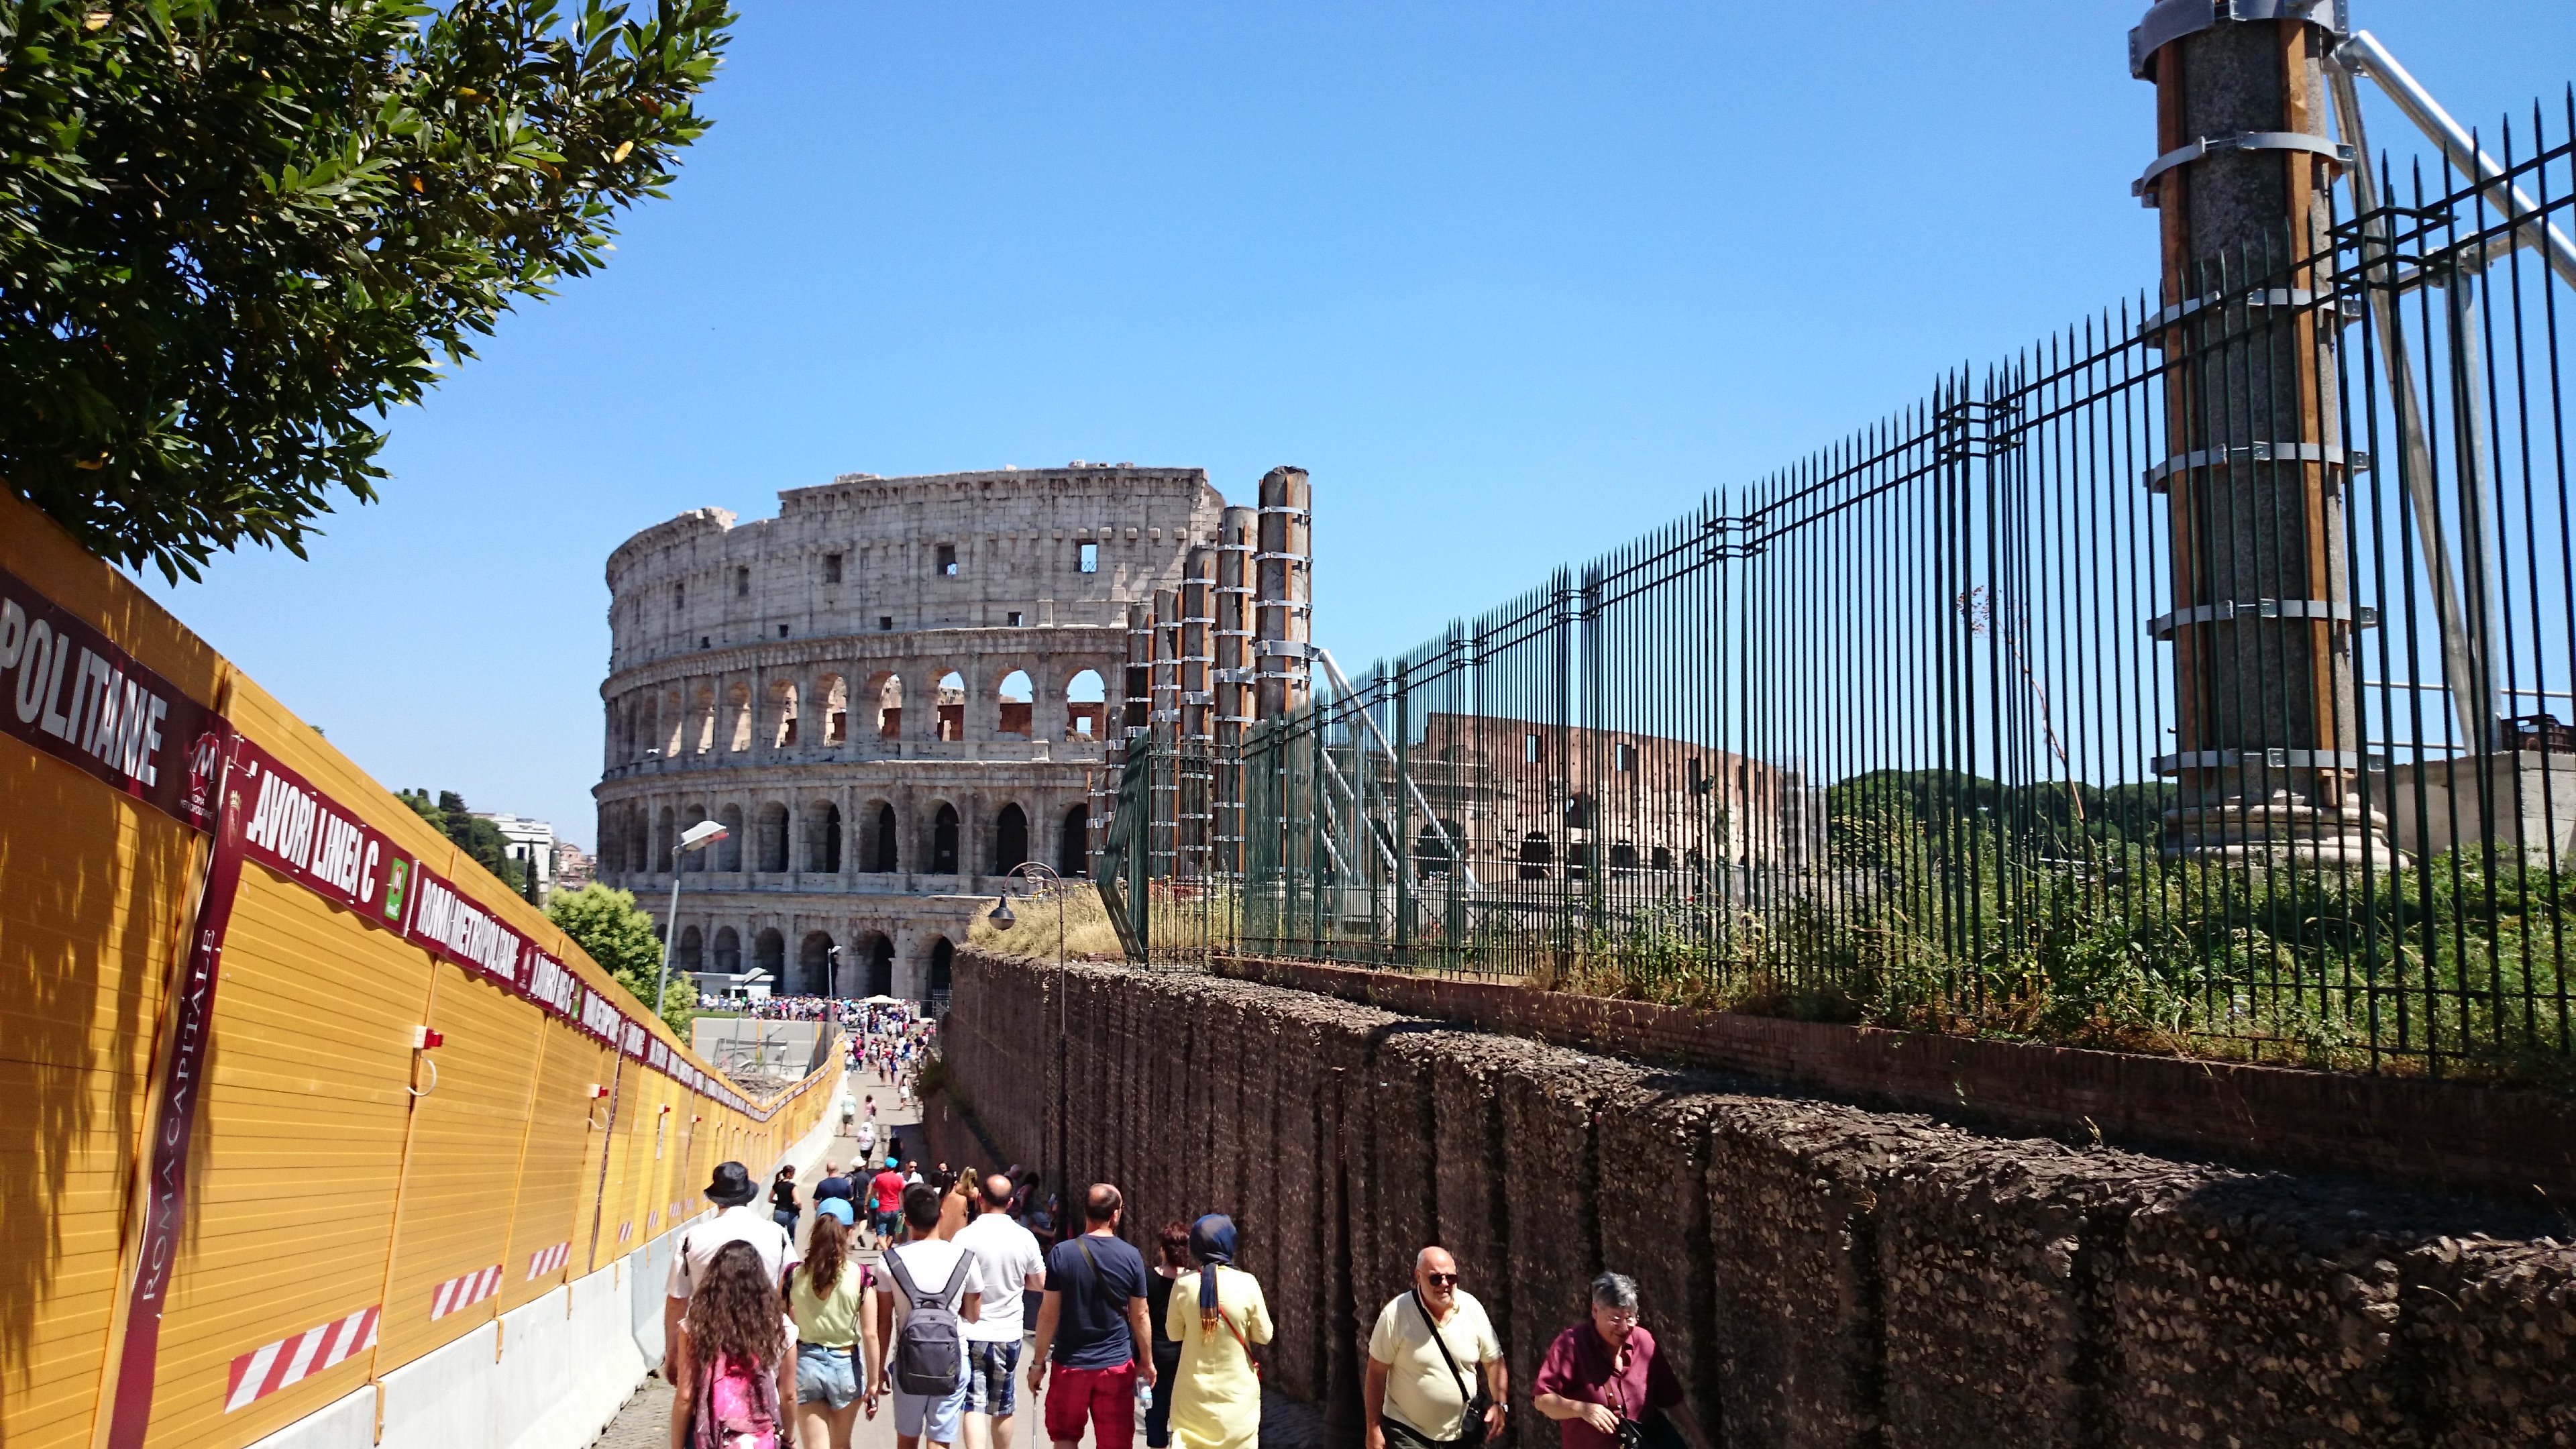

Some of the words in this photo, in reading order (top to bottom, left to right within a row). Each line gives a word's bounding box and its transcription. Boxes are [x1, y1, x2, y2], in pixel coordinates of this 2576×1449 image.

[0, 597, 168, 788] POLITANE
[311, 808, 363, 897] LINEA
[360, 840, 379, 903] C
[416, 877, 456, 945] ROMA
[449, 899, 520, 981] METROPOLITANE
[142, 1159, 174, 1299] ROMA
[168, 929, 215, 1146] CAPITALE
